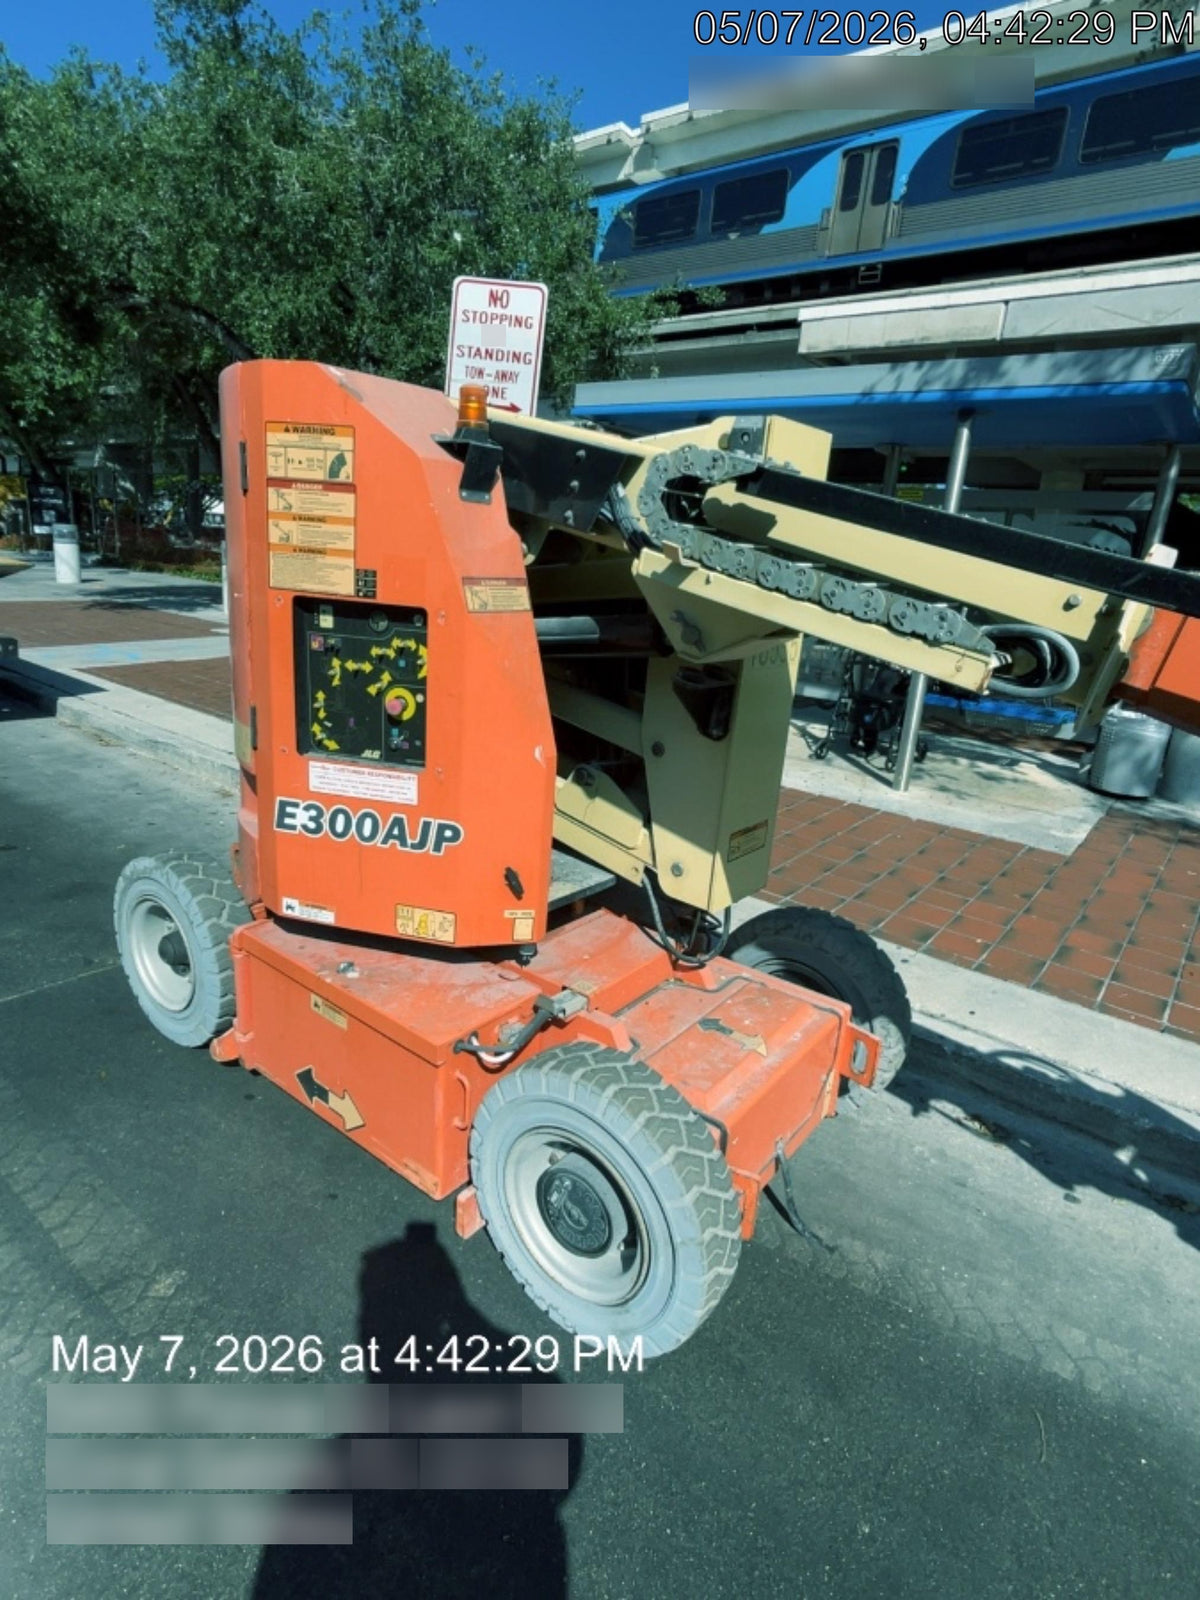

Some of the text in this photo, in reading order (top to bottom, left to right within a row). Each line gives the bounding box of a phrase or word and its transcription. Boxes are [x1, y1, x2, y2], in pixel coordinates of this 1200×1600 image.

[488, 288, 510, 309] NO
[461, 309, 534, 329] STOPPING
[456, 344, 533, 365] STANDING
[292, 425, 336, 436] WARNING
[275, 797, 464, 856] E300AJP
